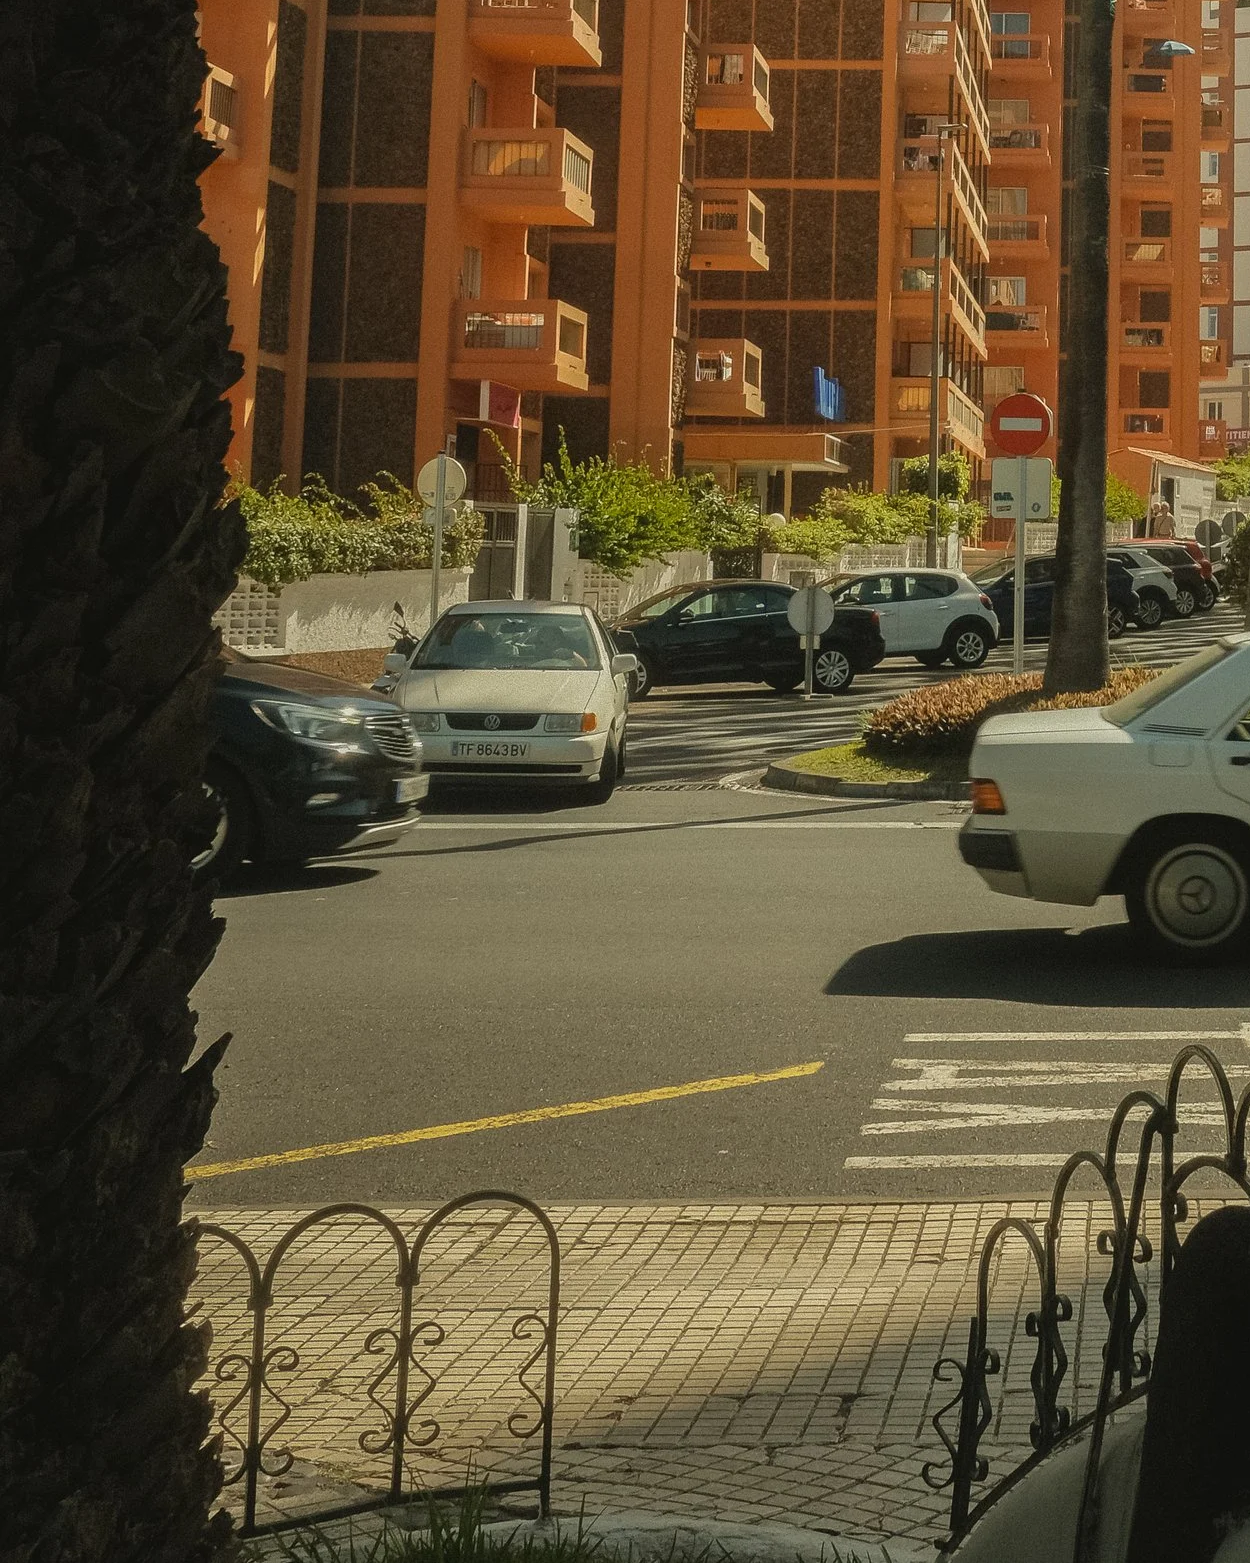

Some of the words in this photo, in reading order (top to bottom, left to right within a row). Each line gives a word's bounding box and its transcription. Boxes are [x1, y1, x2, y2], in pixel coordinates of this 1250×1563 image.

[459, 743, 474, 755] TF
[476, 744, 509, 756] 8643
[510, 744, 527, 756] BV
